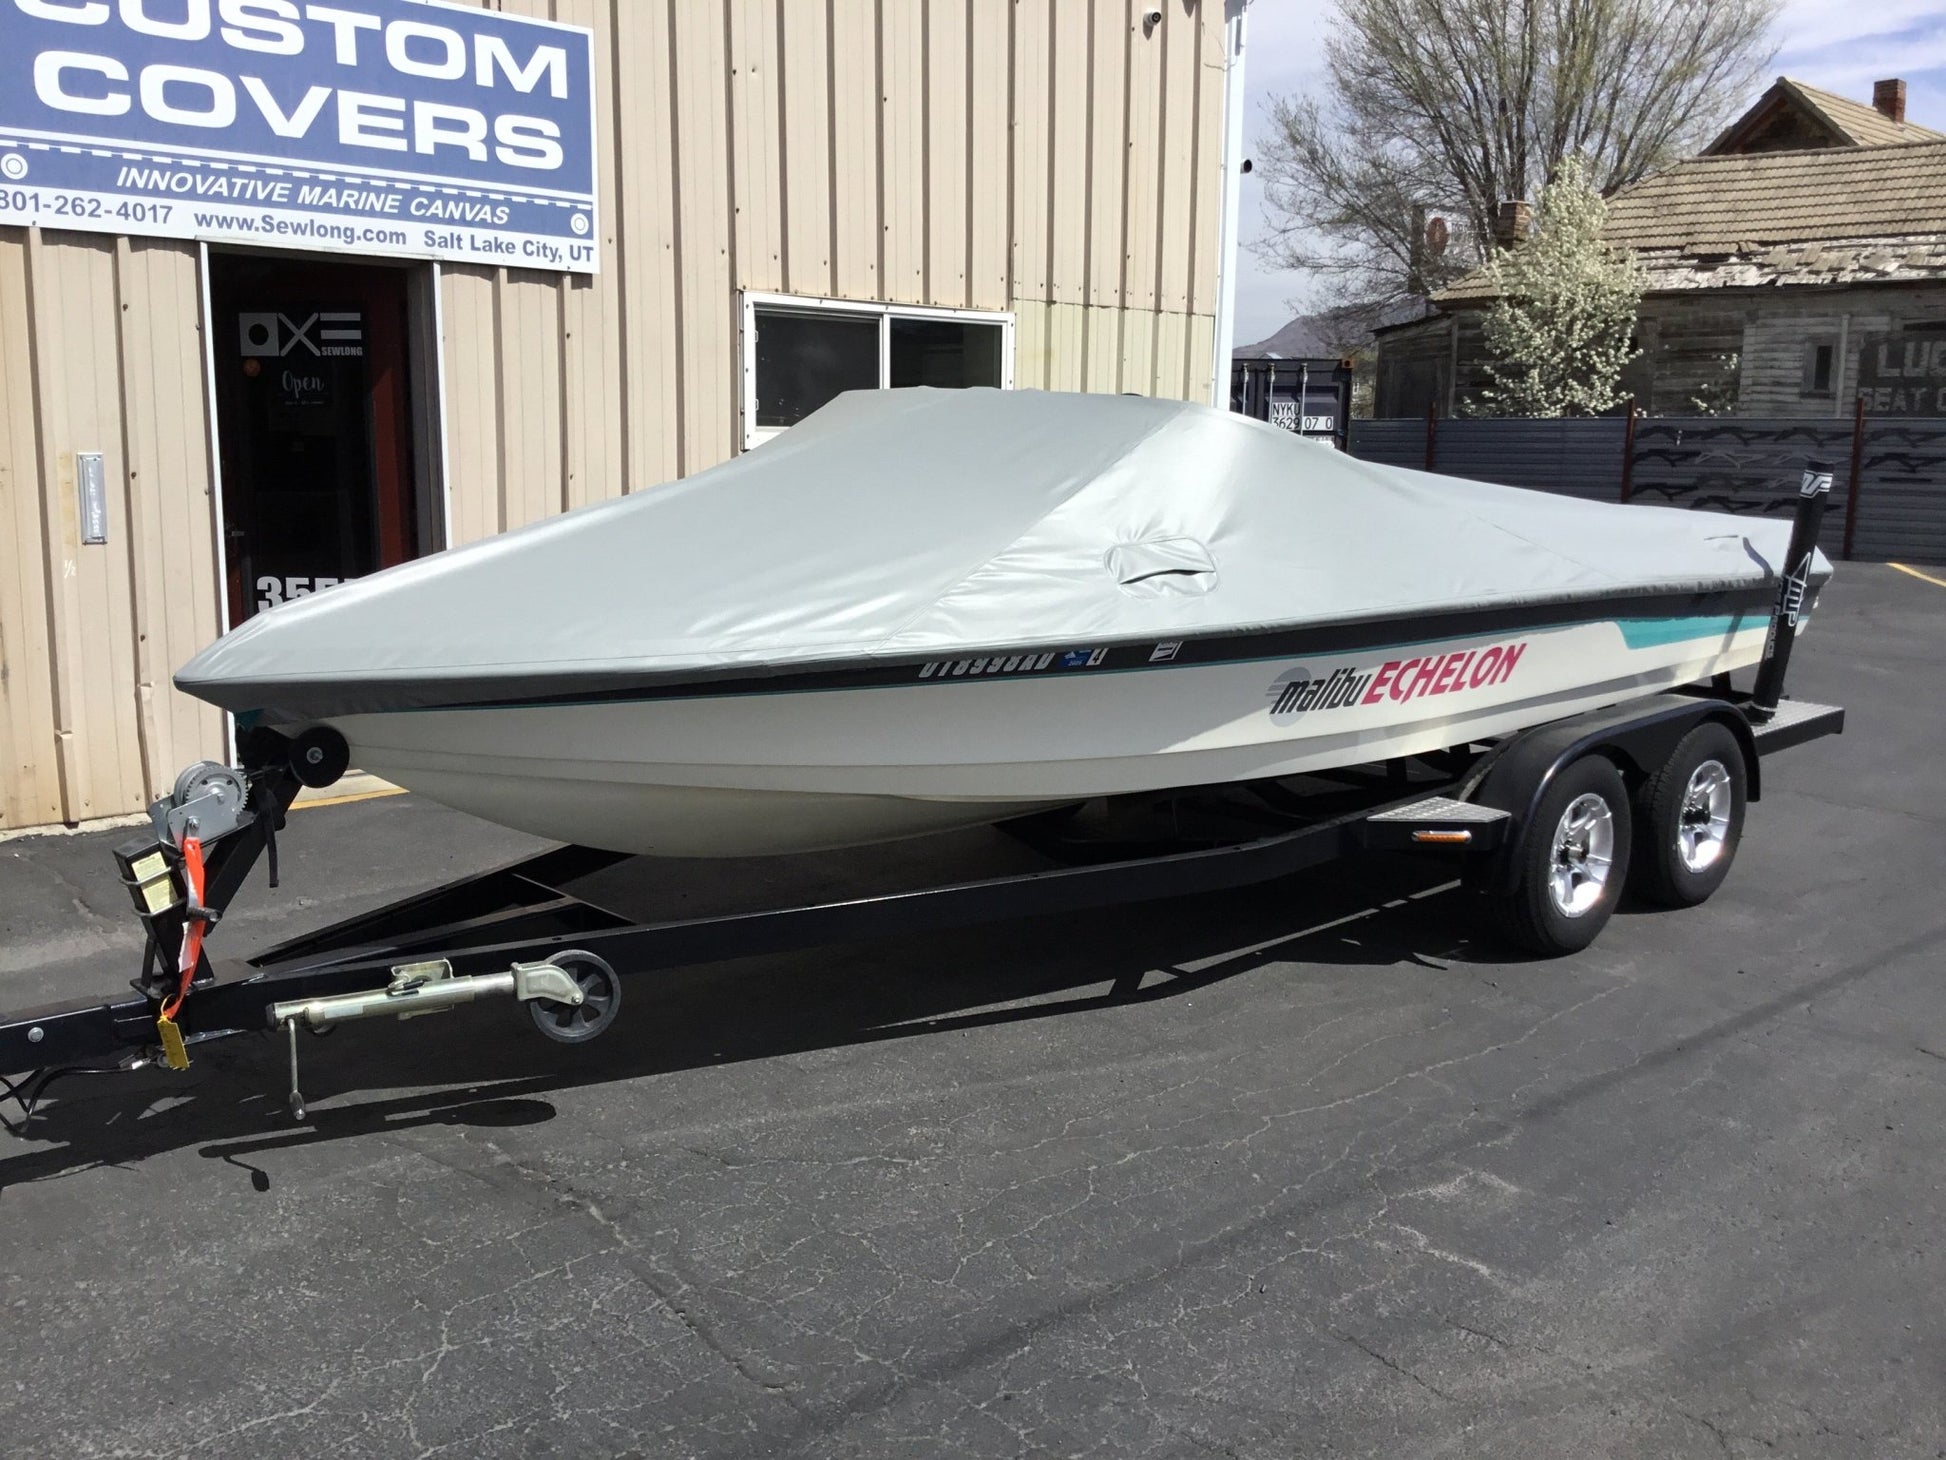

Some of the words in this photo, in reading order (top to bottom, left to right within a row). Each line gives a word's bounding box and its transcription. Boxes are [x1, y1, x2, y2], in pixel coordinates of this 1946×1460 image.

[33, 50, 564, 170] COVERS
[117, 166, 291, 202] INNOVATIVE
[297, 186, 401, 213] MARINE
[410, 197, 510, 224] CANVAS
[0, 189, 173, 225] 801-262-4017
[194, 210, 407, 246] www.Sewlong.com
[424, 230, 464, 251] Salt
[470, 235, 516, 255] Lake
[522, 240, 563, 264] City,
[569, 244, 594, 263] UT
[321, 346, 363, 356] SEWLONG
[282, 369, 325, 399] Open
[1272, 403, 1300, 417] NYKU
[1270, 667, 1372, 715] malibu
[1360, 643, 1527, 705] ECHELON
